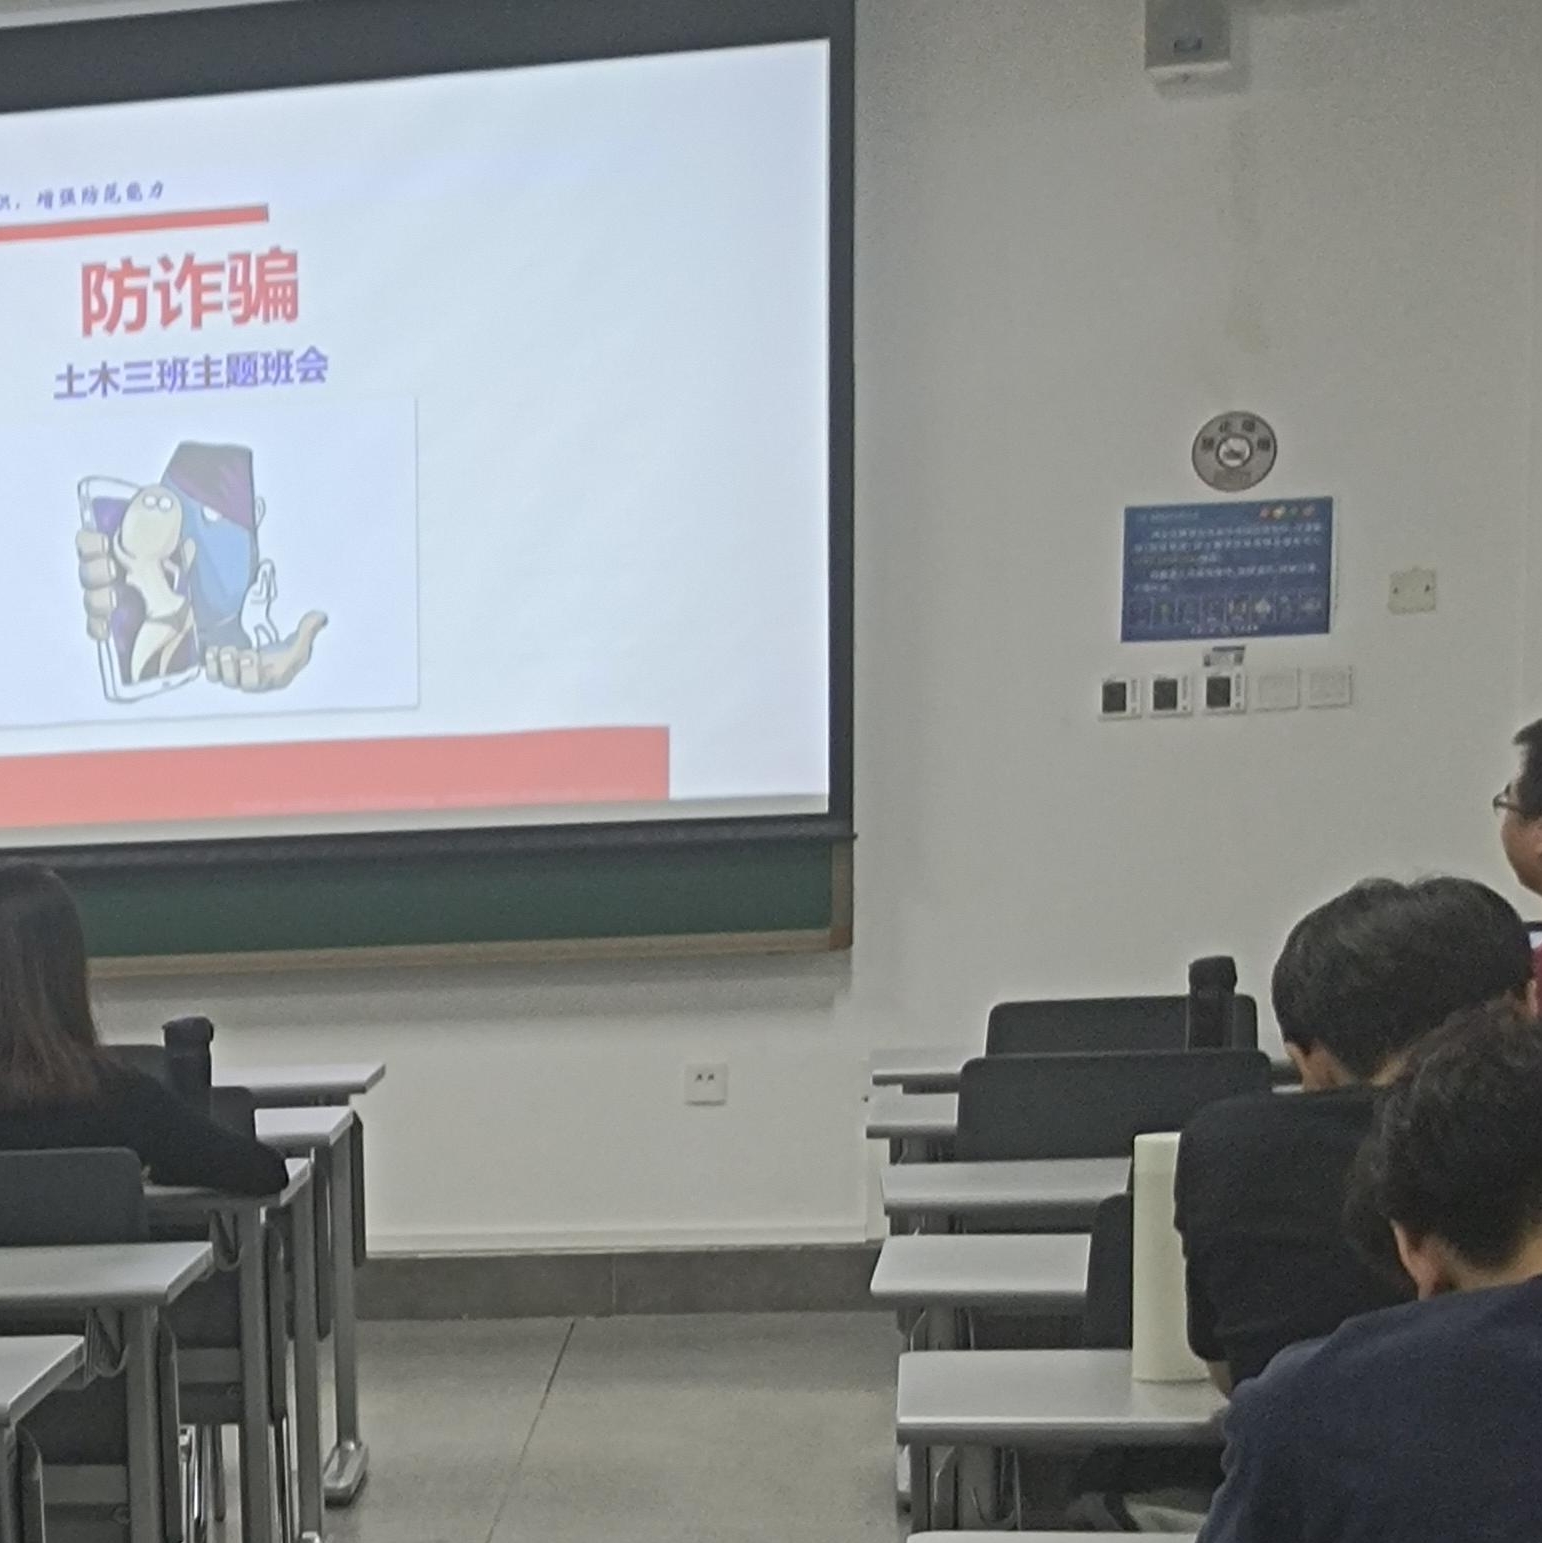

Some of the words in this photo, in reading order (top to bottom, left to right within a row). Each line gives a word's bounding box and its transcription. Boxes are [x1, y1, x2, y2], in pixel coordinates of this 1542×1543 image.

[80, 245, 300, 337] 防诈骗
[53, 345, 329, 400] 土木三班主题班会
